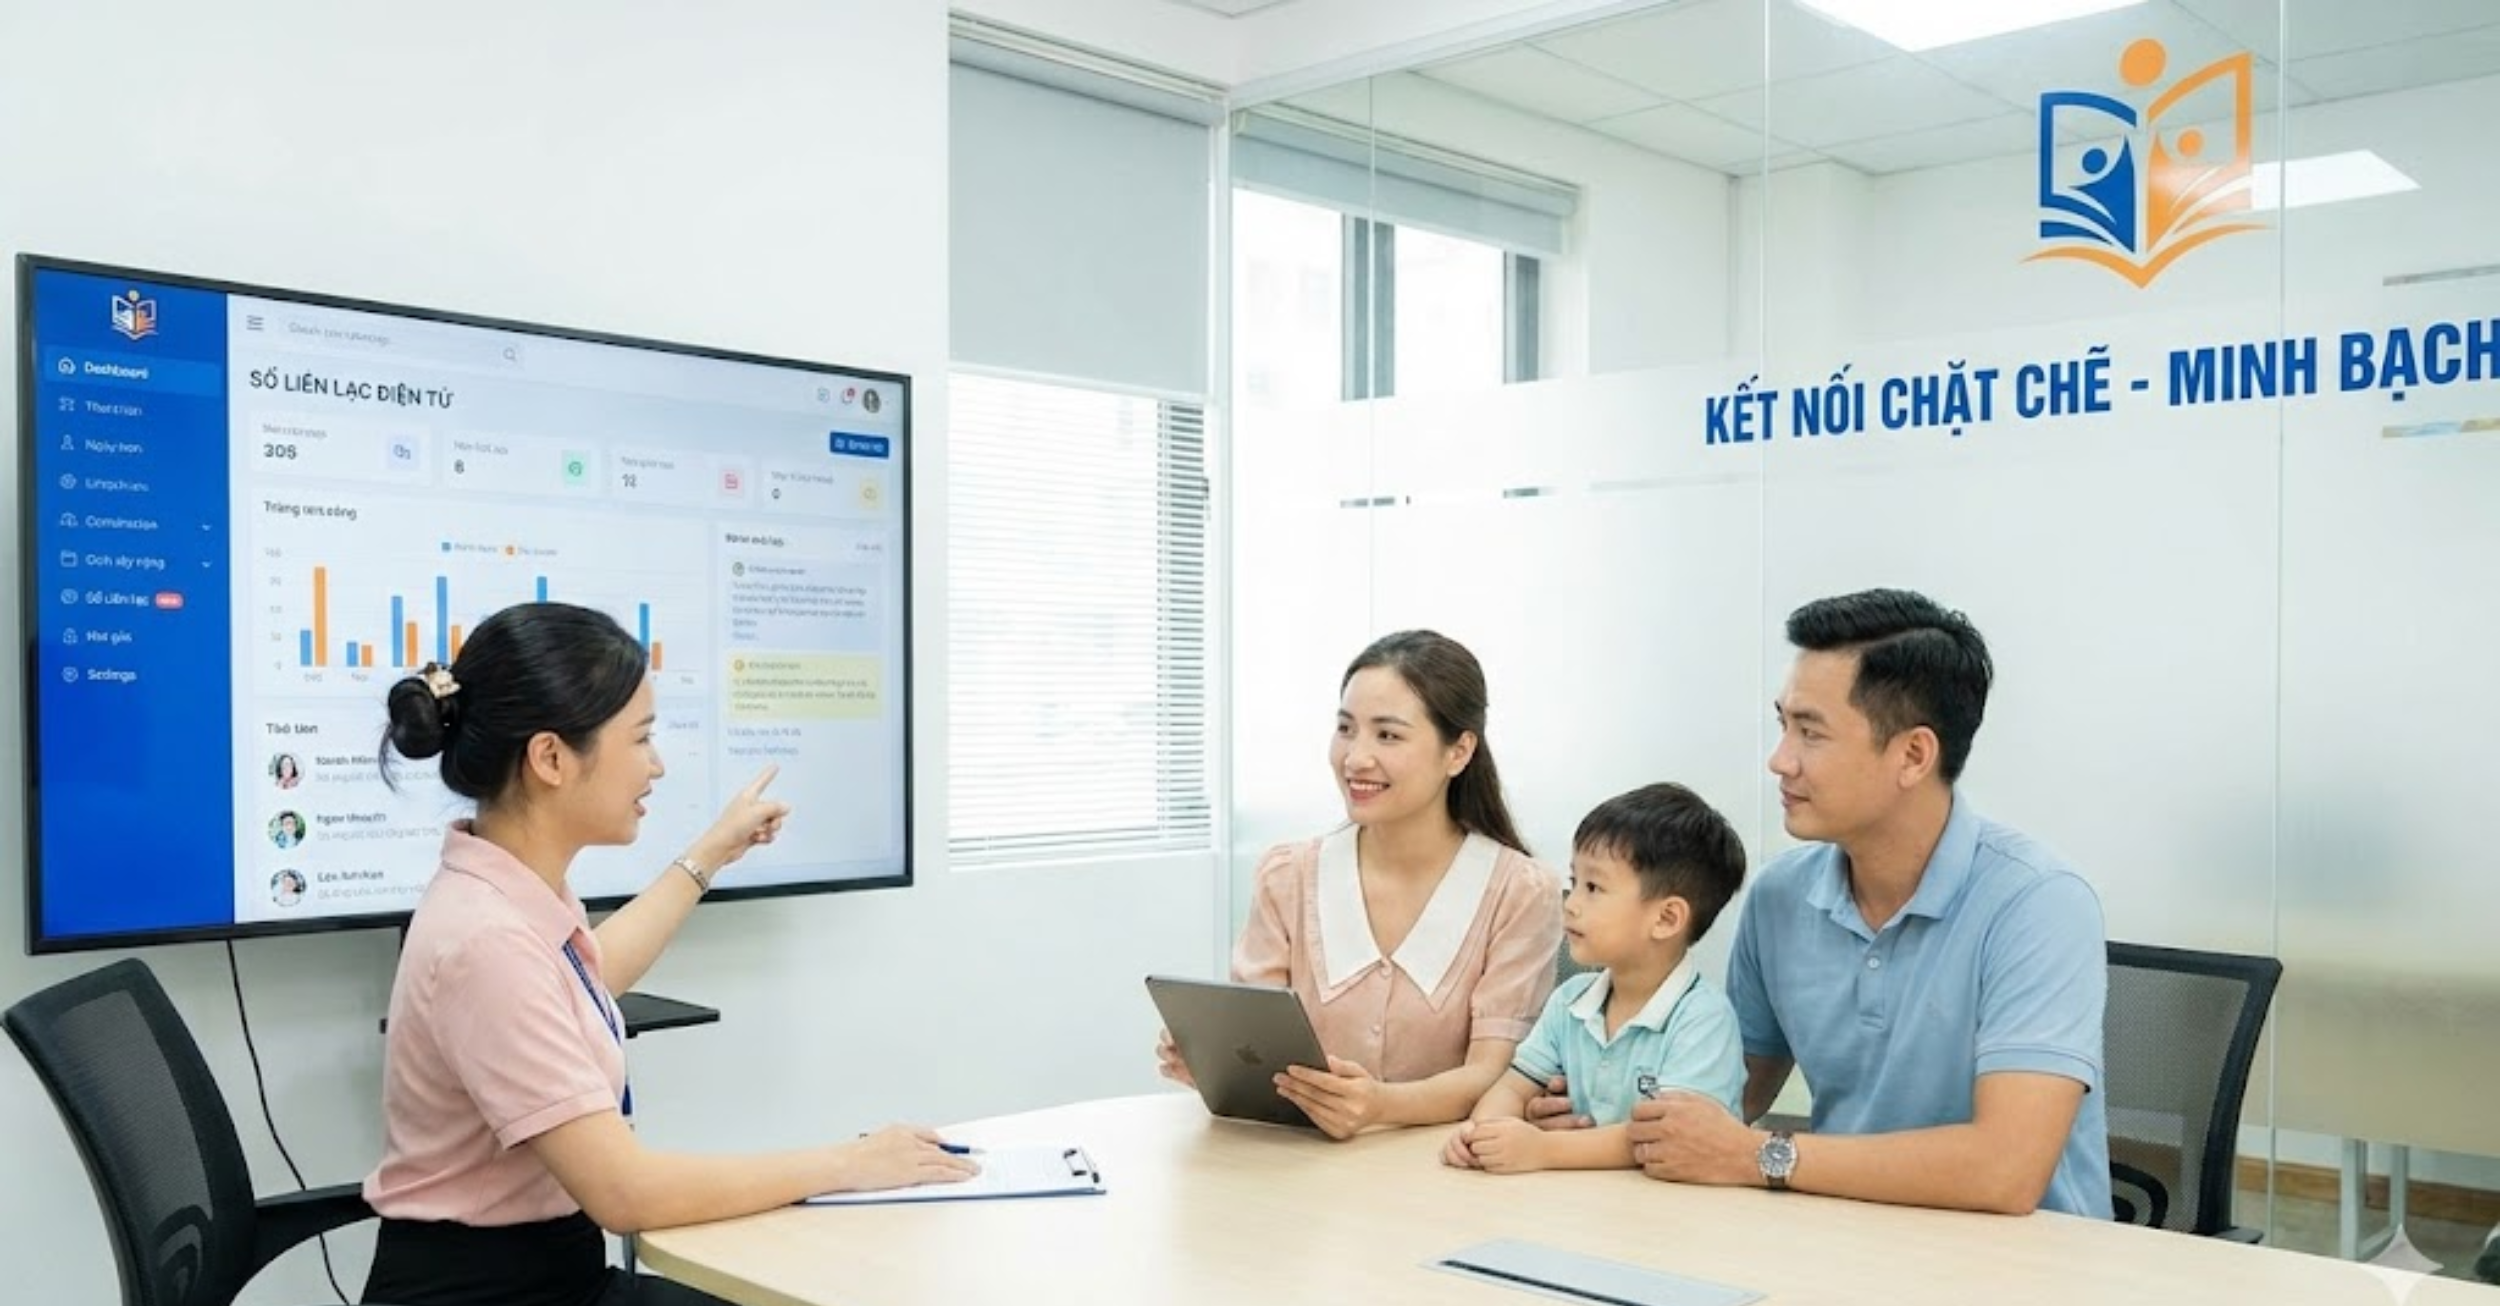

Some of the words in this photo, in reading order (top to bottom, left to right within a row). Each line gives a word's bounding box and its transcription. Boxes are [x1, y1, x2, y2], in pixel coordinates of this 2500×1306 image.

[334, 379, 372, 402] LẠC
[1706, 374, 1778, 445] KẾT
[1793, 363, 1865, 437] NỐI
[1881, 359, 1998, 436] CHẶT
[2016, 345, 2111, 418] CHẼ
[2169, 337, 2317, 406] MINH
[2340, 319, 2500, 401] BẠCH
